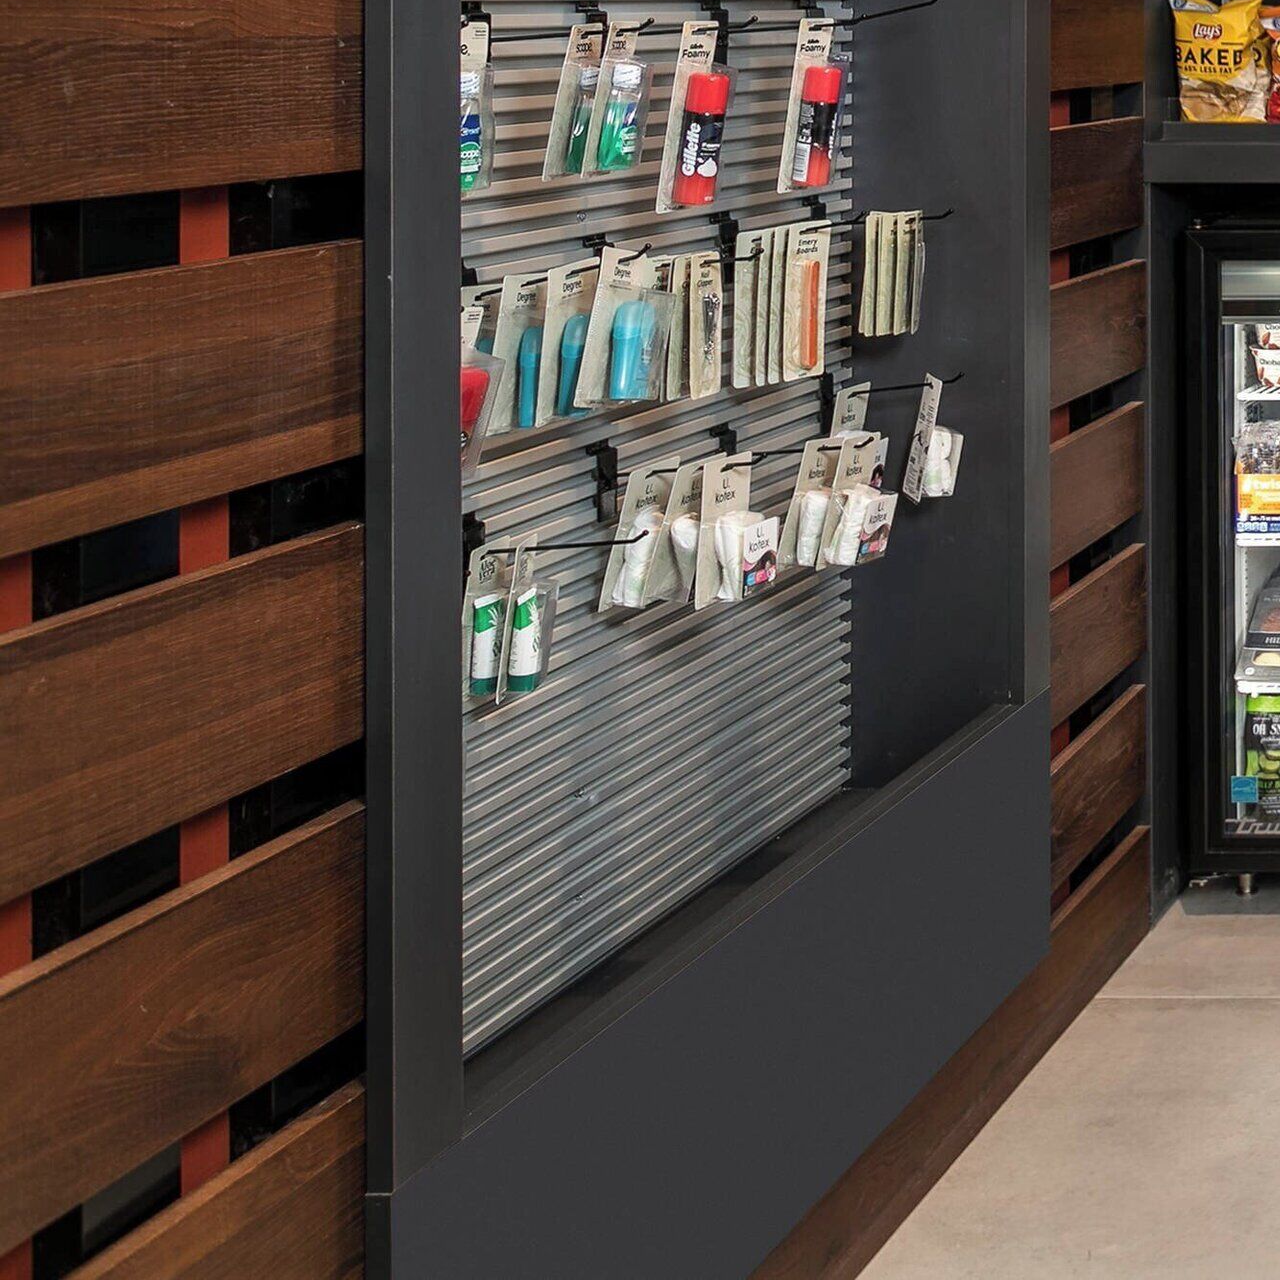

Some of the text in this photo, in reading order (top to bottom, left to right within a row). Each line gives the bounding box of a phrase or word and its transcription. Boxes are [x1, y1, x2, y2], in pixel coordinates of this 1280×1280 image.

[1194, 23, 1222, 40] Lay's
[682, 49, 711, 60] Foamy
[800, 44, 827, 54] Foamy
[1176, 48, 1243, 66] BAKED
[1219, 66, 1232, 74] FAT
[681, 122, 702, 177] Gillette
[614, 266, 632, 280] Degree
[562, 280, 582, 293] Degree
[517, 291, 537, 303] Degree
[635, 493, 659, 510] kotex
[715, 488, 737, 504] kotex
[749, 537, 771, 554] kotex
[1252, 723, 1267, 736] OH
